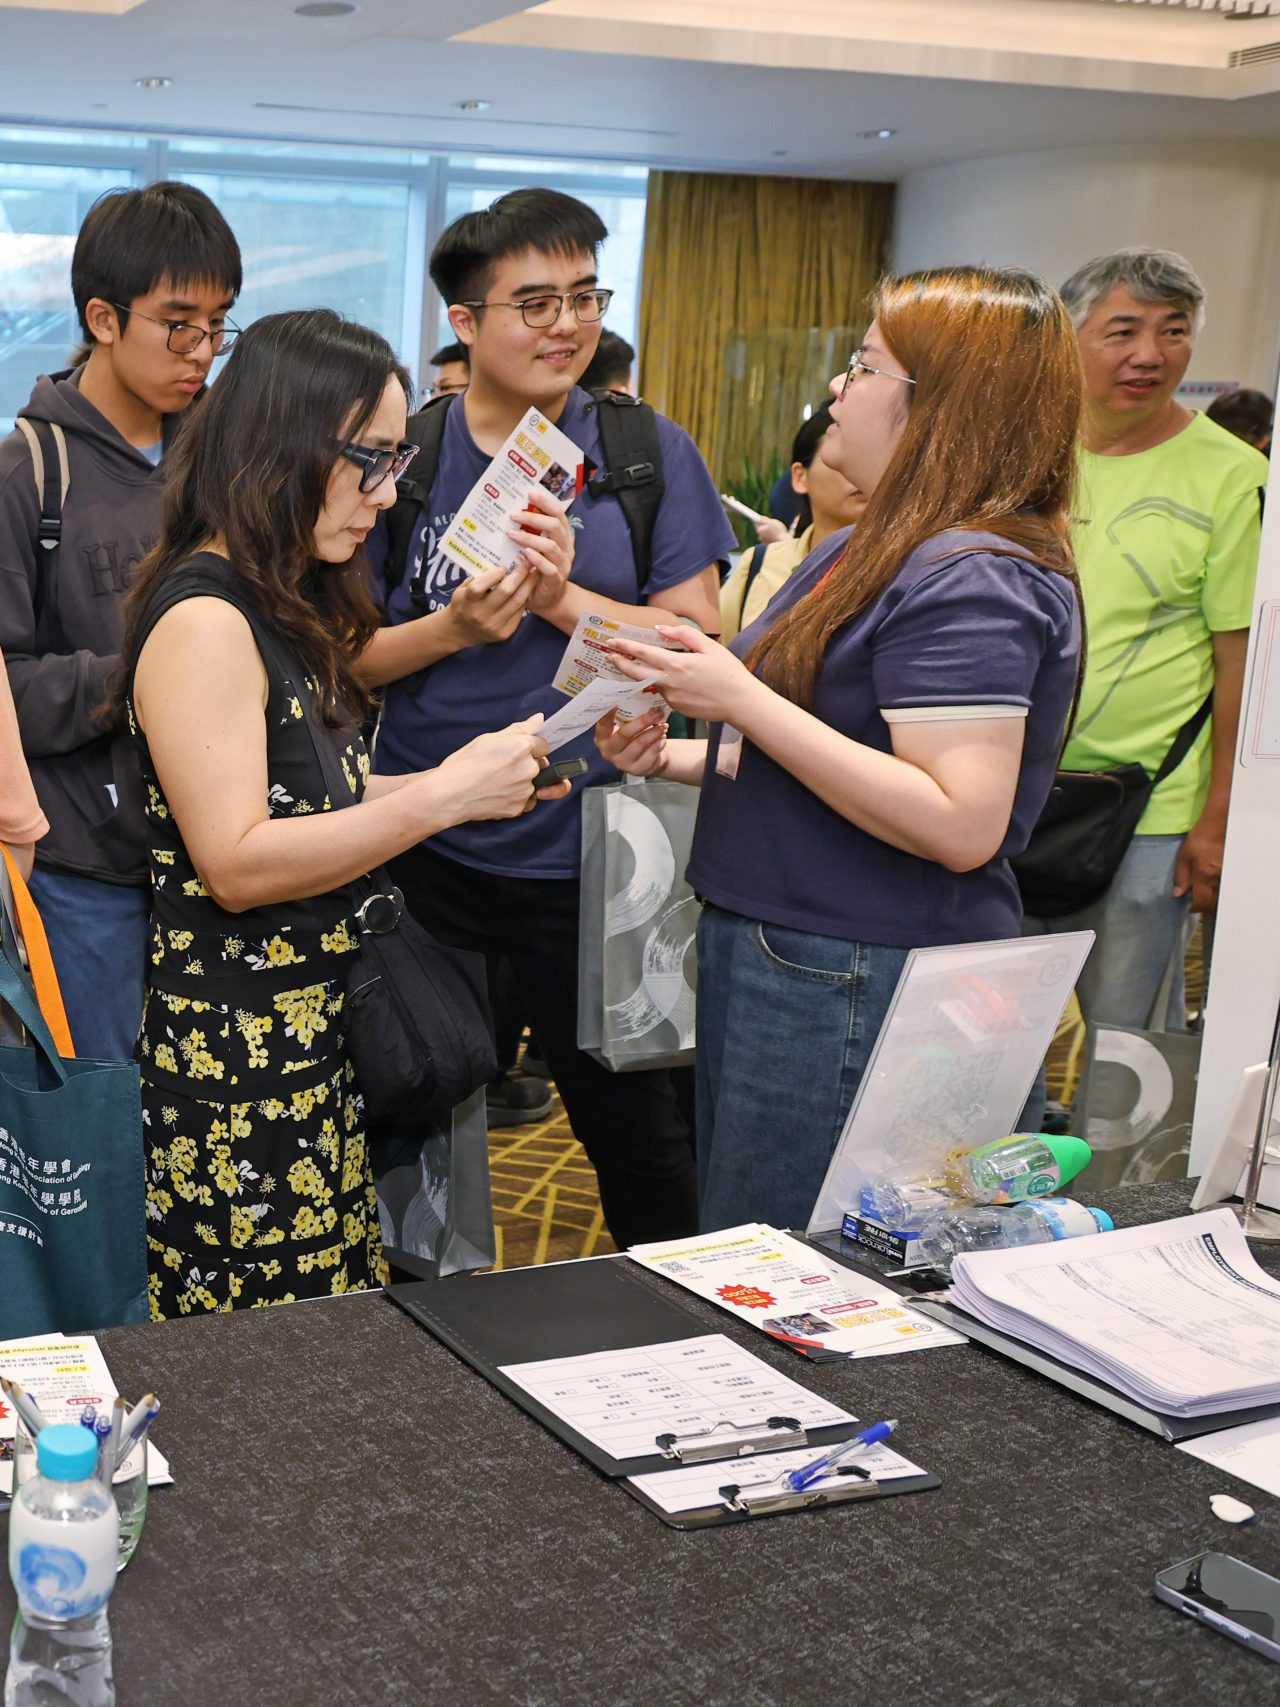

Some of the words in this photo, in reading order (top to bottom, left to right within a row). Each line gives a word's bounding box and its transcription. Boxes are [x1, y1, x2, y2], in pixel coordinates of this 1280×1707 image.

[50, 1208, 59, 1216] of
[863, 1224, 878, 1236] FINE
[1204, 1237, 1241, 1281] EMPLOYMENT
